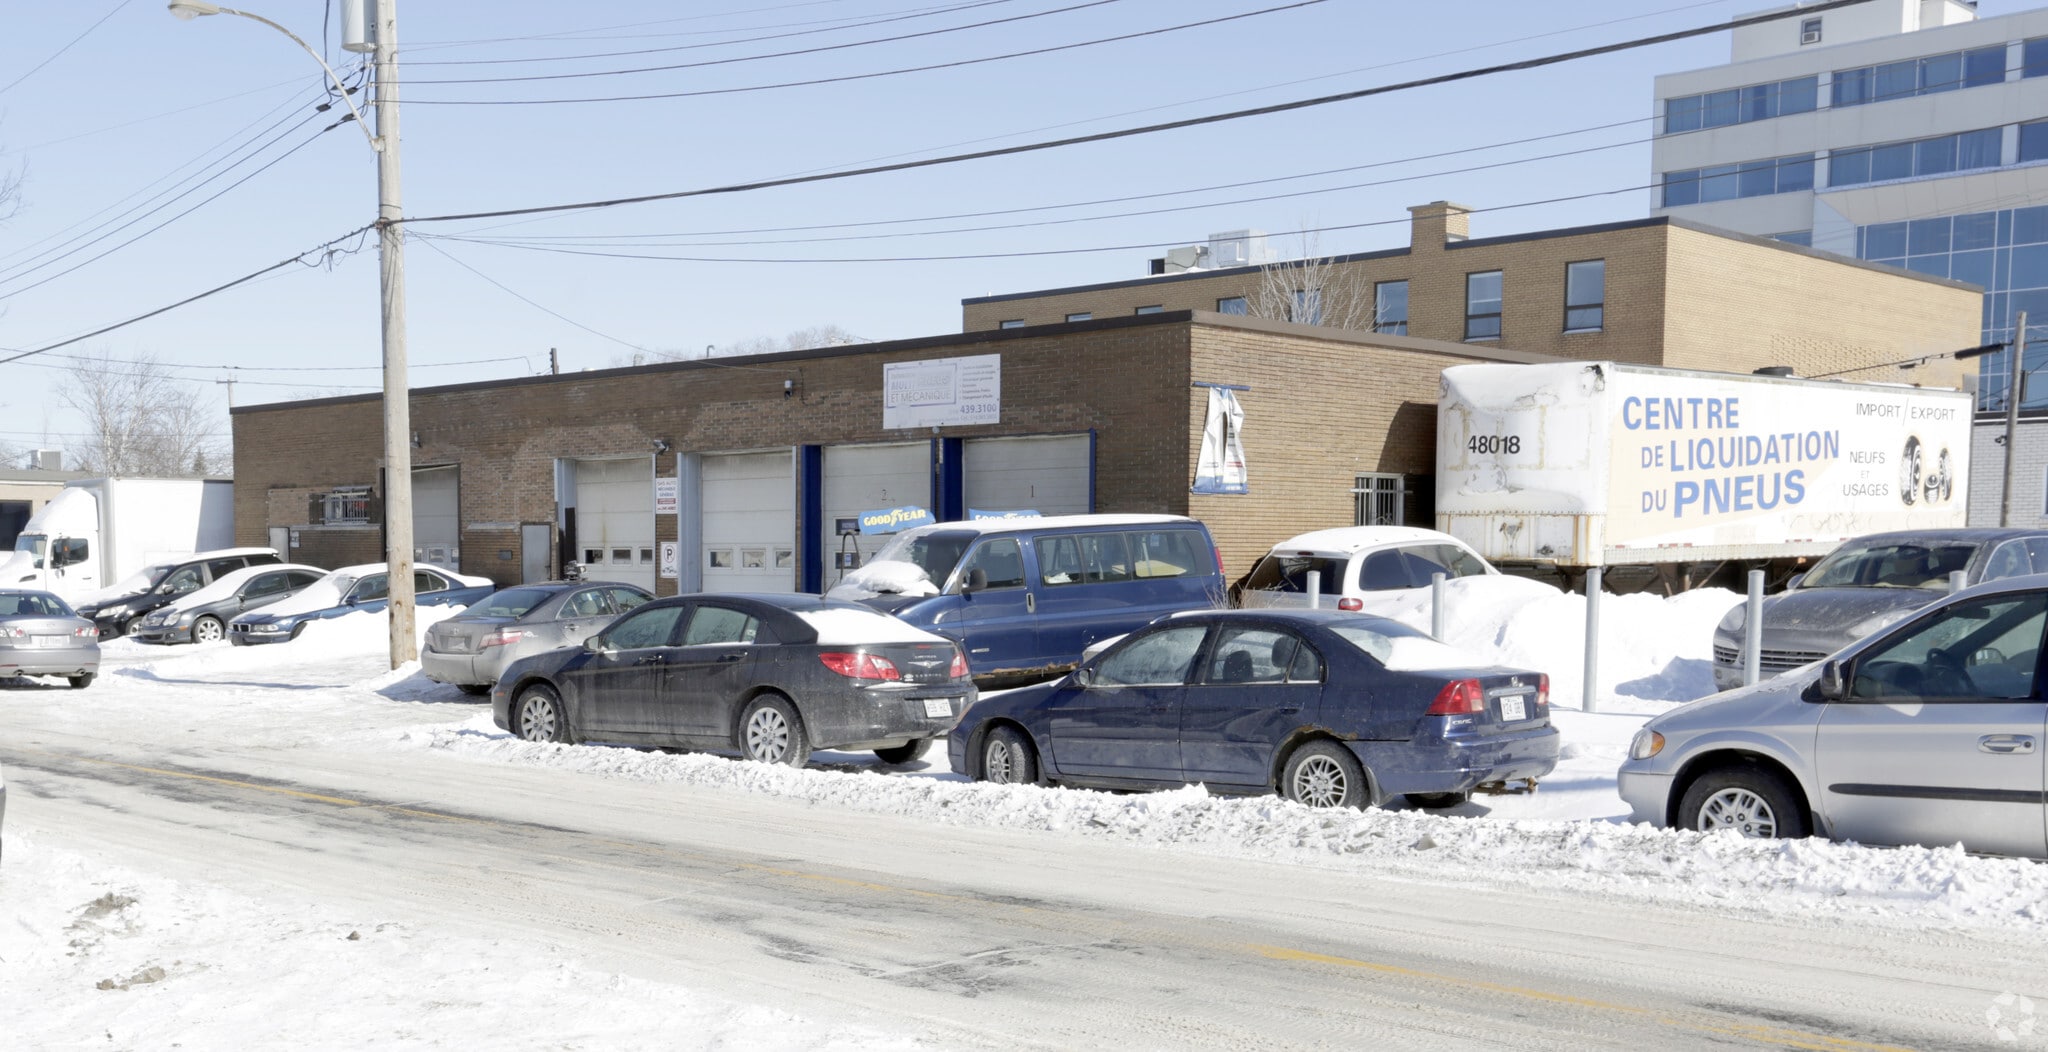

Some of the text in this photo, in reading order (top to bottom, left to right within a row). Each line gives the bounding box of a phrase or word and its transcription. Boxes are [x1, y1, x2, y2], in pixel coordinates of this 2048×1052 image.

[960, 403, 997, 414] 439.3100
[1622, 396, 1739, 431] CENTRE
[1855, 402, 1901, 418] IMPORT
[1911, 406, 1956, 421] EXPORT
[1468, 435, 1520, 455] 48018
[1641, 430, 1839, 472] DE LIQUIDATION
[1849, 450, 1886, 464] NEUFS
[1860, 470, 1870, 479] ET
[1641, 469, 1805, 519] DU PNEUS
[1842, 483, 1889, 497] USAGES
[863, 508, 926, 527] GOODYEAR
